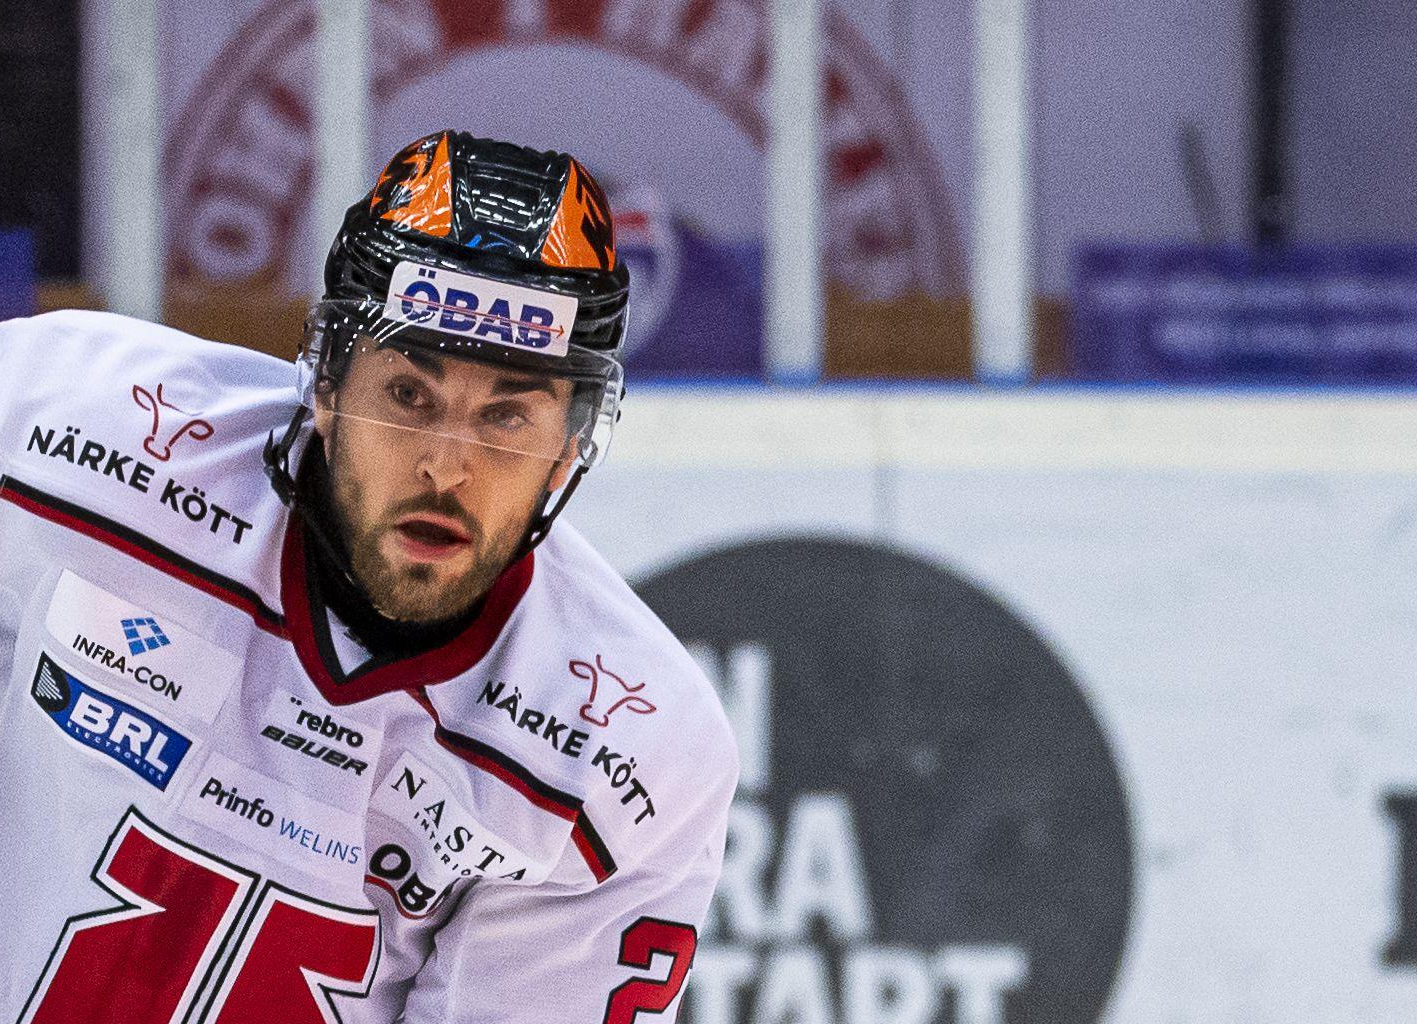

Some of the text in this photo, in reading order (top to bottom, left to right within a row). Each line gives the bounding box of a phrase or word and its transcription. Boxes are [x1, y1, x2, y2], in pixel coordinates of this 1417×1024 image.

[401, 268, 555, 348] ÖBAB
[27, 425, 253, 545] NÄRKE KÖTT
[72, 634, 183, 702] INFRA-CON
[69, 691, 169, 773] BRL
[290, 697, 364, 748] rebro
[477, 680, 656, 826] NÄRKE KÖTT
[199, 777, 362, 865] Prinfo WELINS
[391, 767, 527, 881] NASTA
